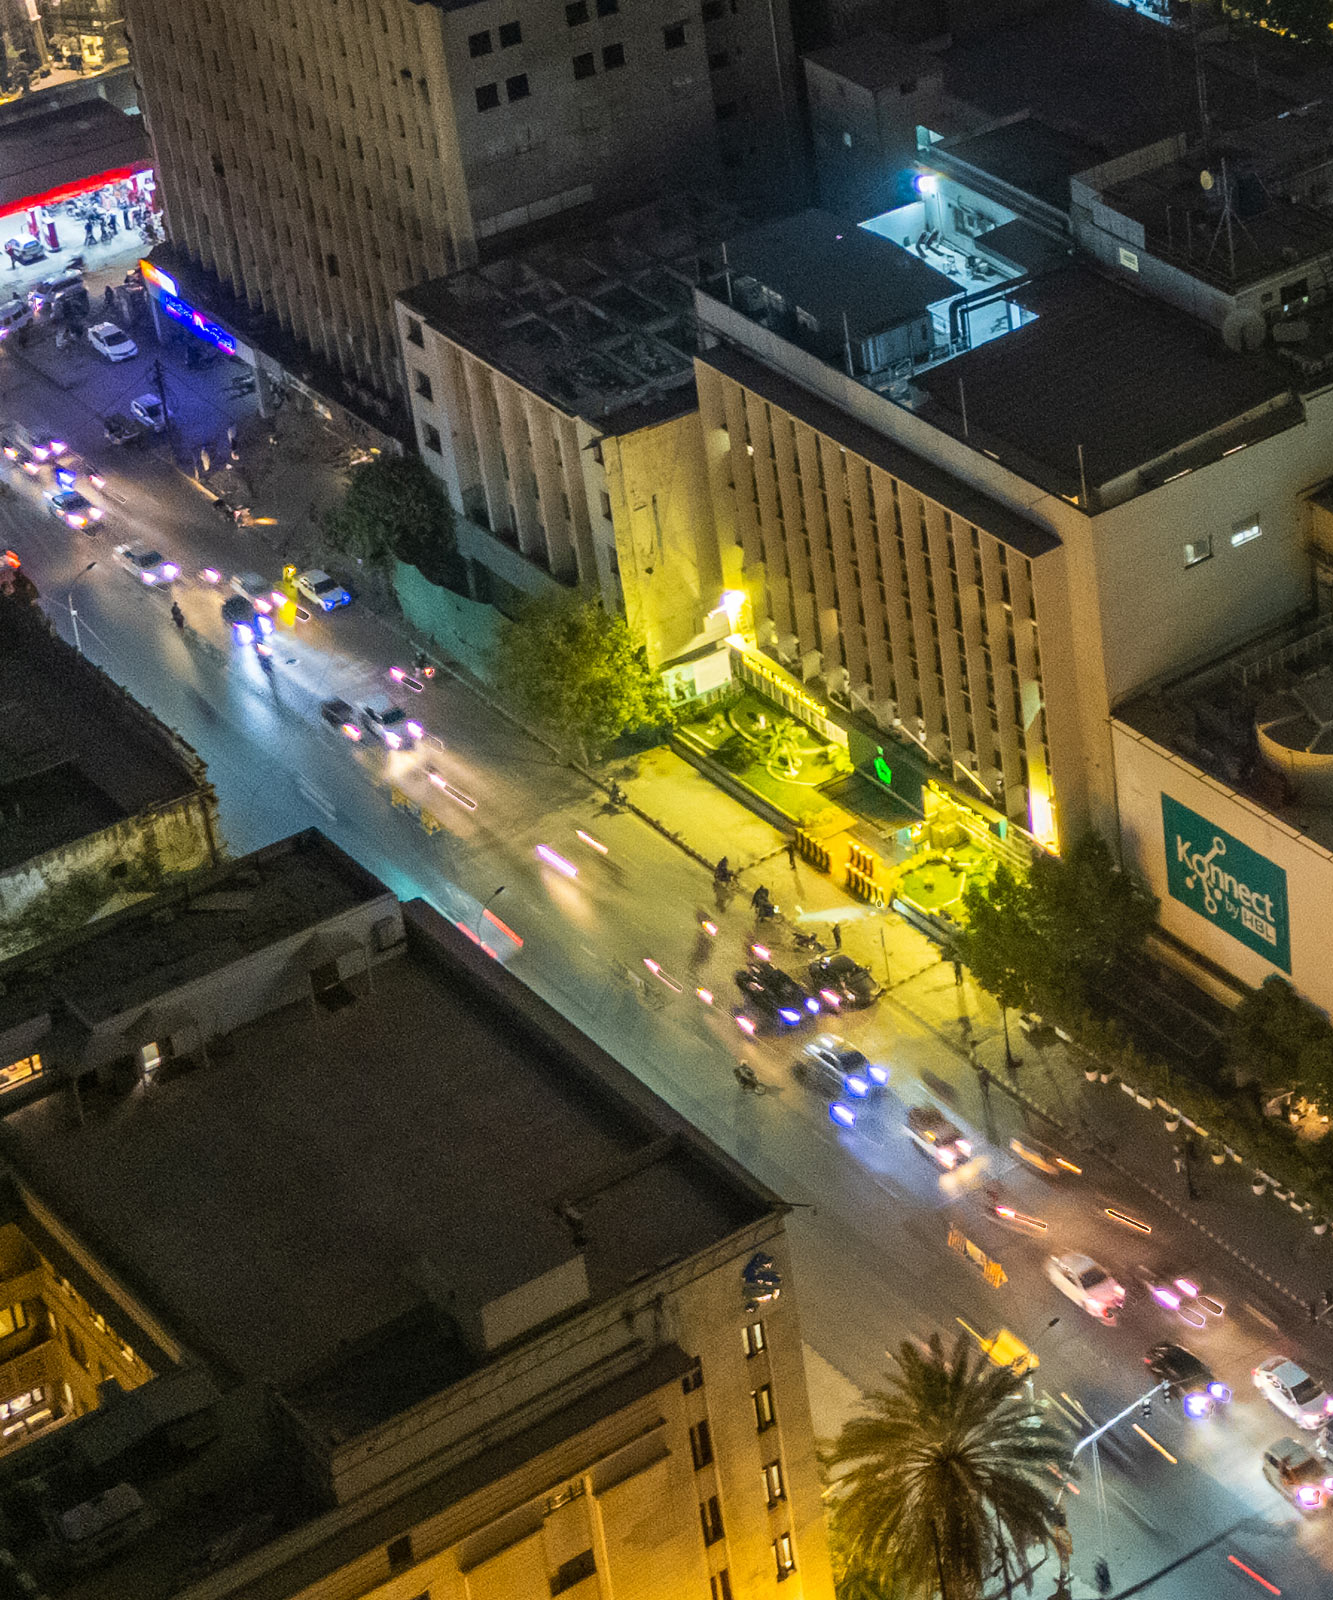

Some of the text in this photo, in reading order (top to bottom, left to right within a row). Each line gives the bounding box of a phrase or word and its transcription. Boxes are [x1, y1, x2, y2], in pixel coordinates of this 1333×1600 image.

[1176, 834, 1276, 923] Konnect
[1225, 895, 1276, 944] by HBL
